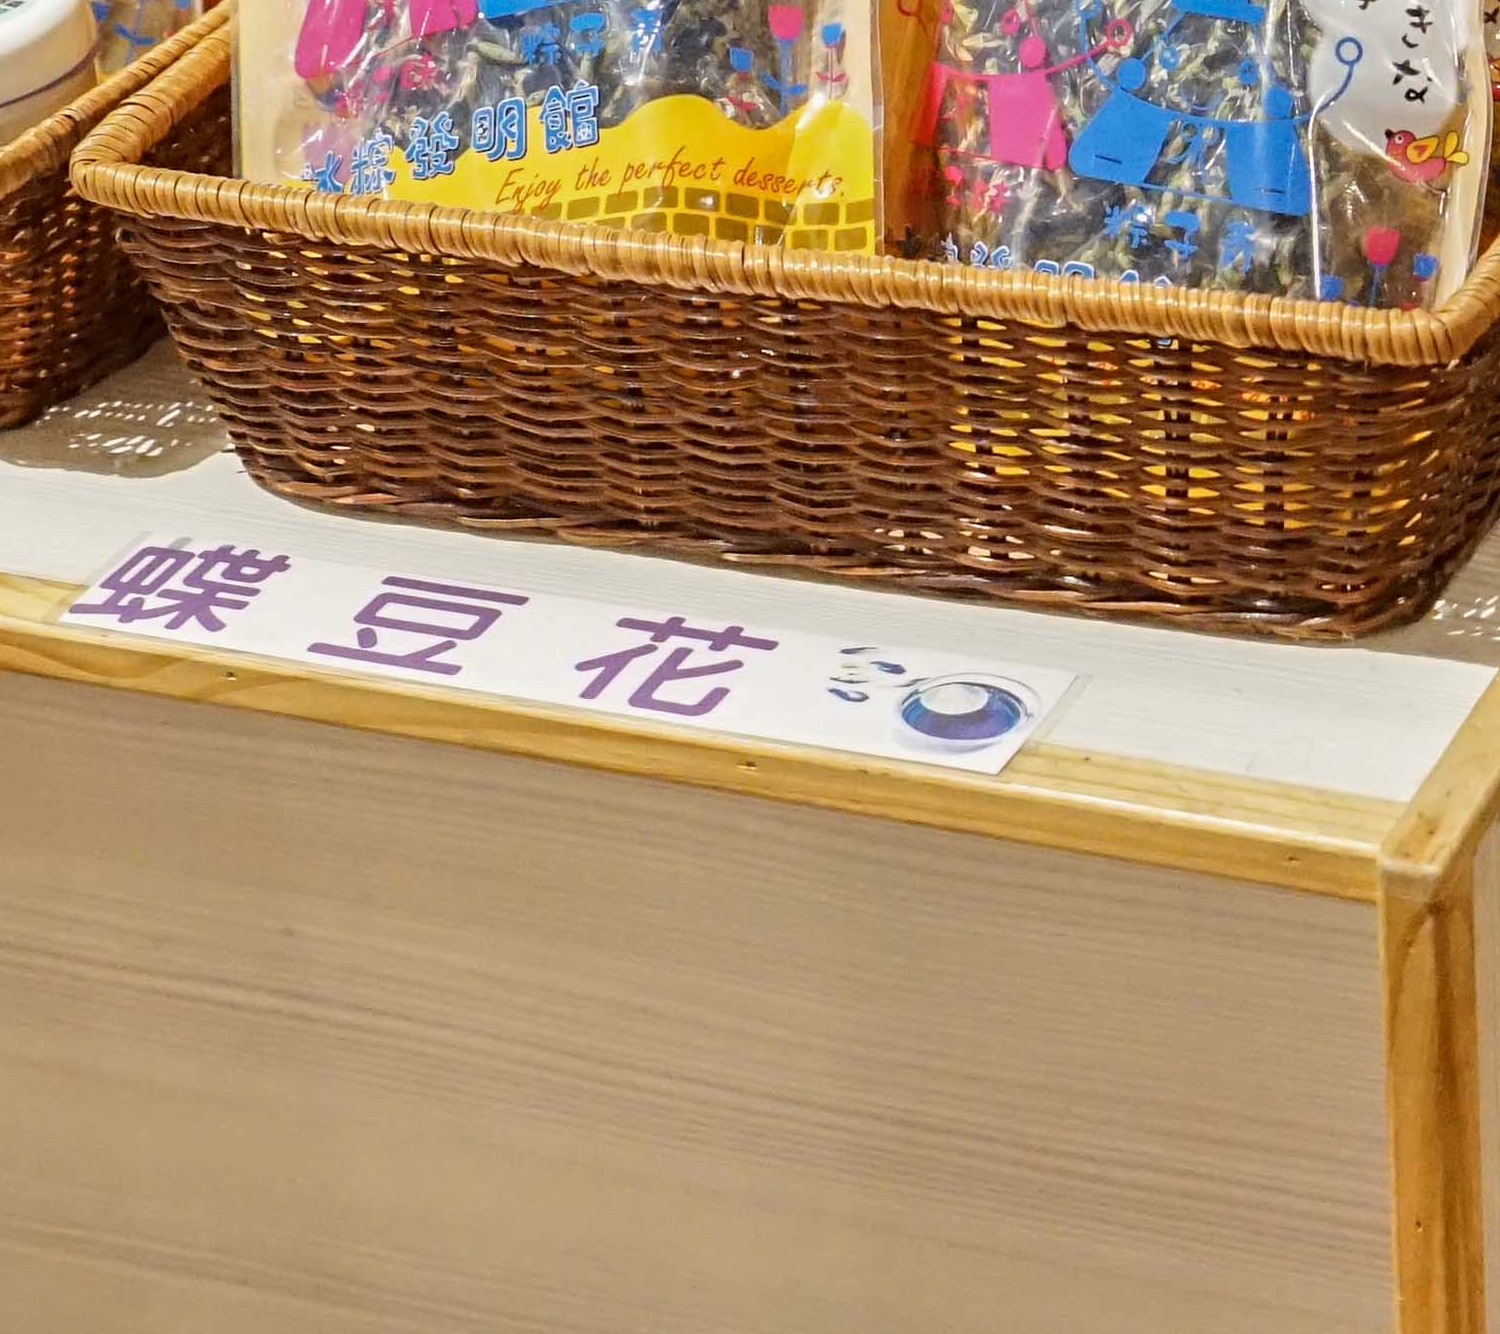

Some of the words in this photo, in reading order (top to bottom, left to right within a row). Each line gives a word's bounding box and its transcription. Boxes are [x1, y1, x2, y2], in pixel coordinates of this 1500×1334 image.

[494, 167, 561, 213] Enjoy
[574, 157, 612, 192] the
[620, 145, 725, 197] perfect
[66, 542, 780, 718] 蝶豆花
